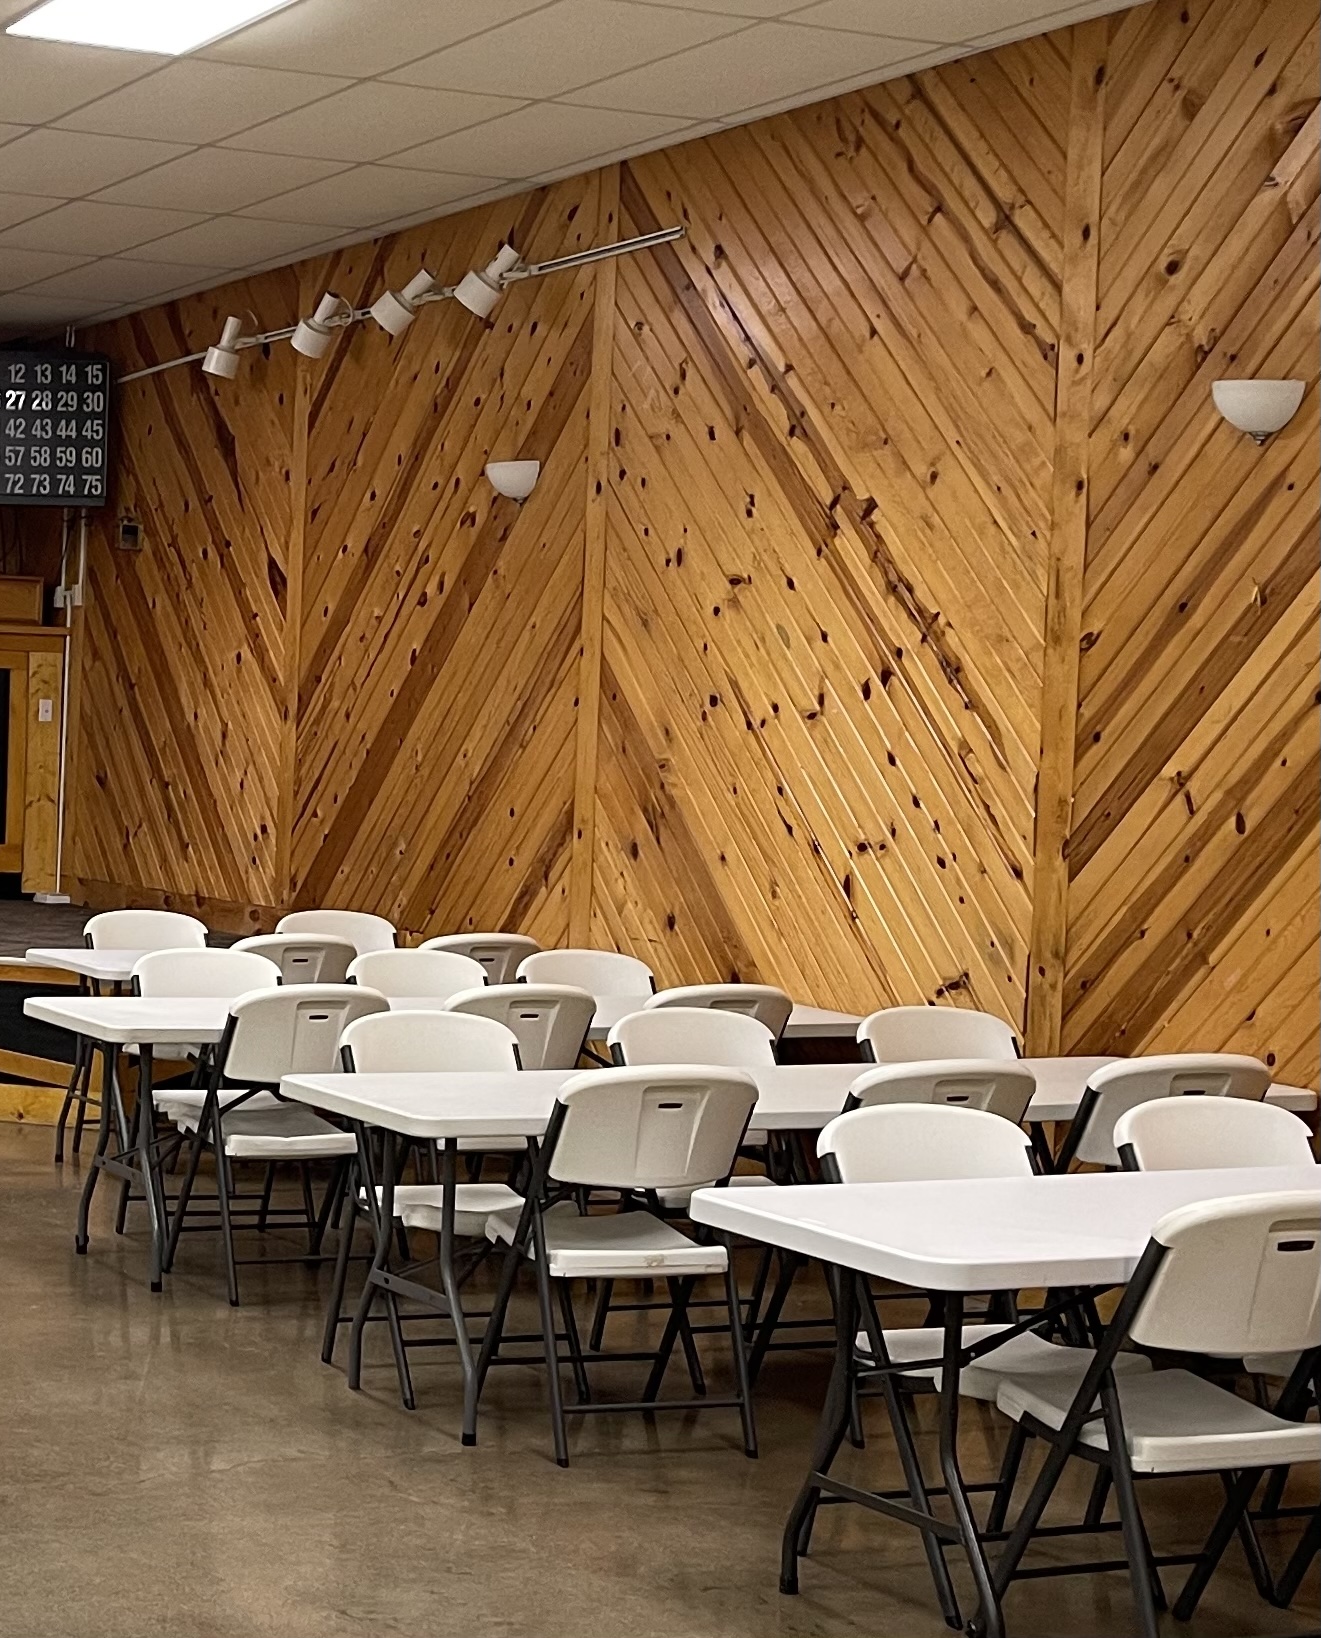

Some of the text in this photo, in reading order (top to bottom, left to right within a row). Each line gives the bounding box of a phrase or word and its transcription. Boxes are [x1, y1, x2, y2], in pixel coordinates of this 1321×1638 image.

[7, 363, 26, 384] 12
[33, 363, 52, 384] 13
[58, 364, 77, 384] 14
[84, 364, 103, 385] 15
[5, 389, 27, 411] 27
[31, 390, 52, 411] 28
[56, 391, 78, 412] 29
[82, 391, 104, 413] 30
[5, 417, 26, 439] 42
[31, 418, 53, 439] 43
[56, 419, 77, 440] 44
[81, 419, 104, 440] 45
[4, 445, 25, 467] 57
[30, 446, 51, 467] 58
[56, 446, 76, 467] 59
[81, 446, 102, 468] 60
[4, 473, 25, 494] 72
[30, 473, 50, 495] 73
[56, 474, 75, 495] 74
[81, 474, 102, 495] 75
